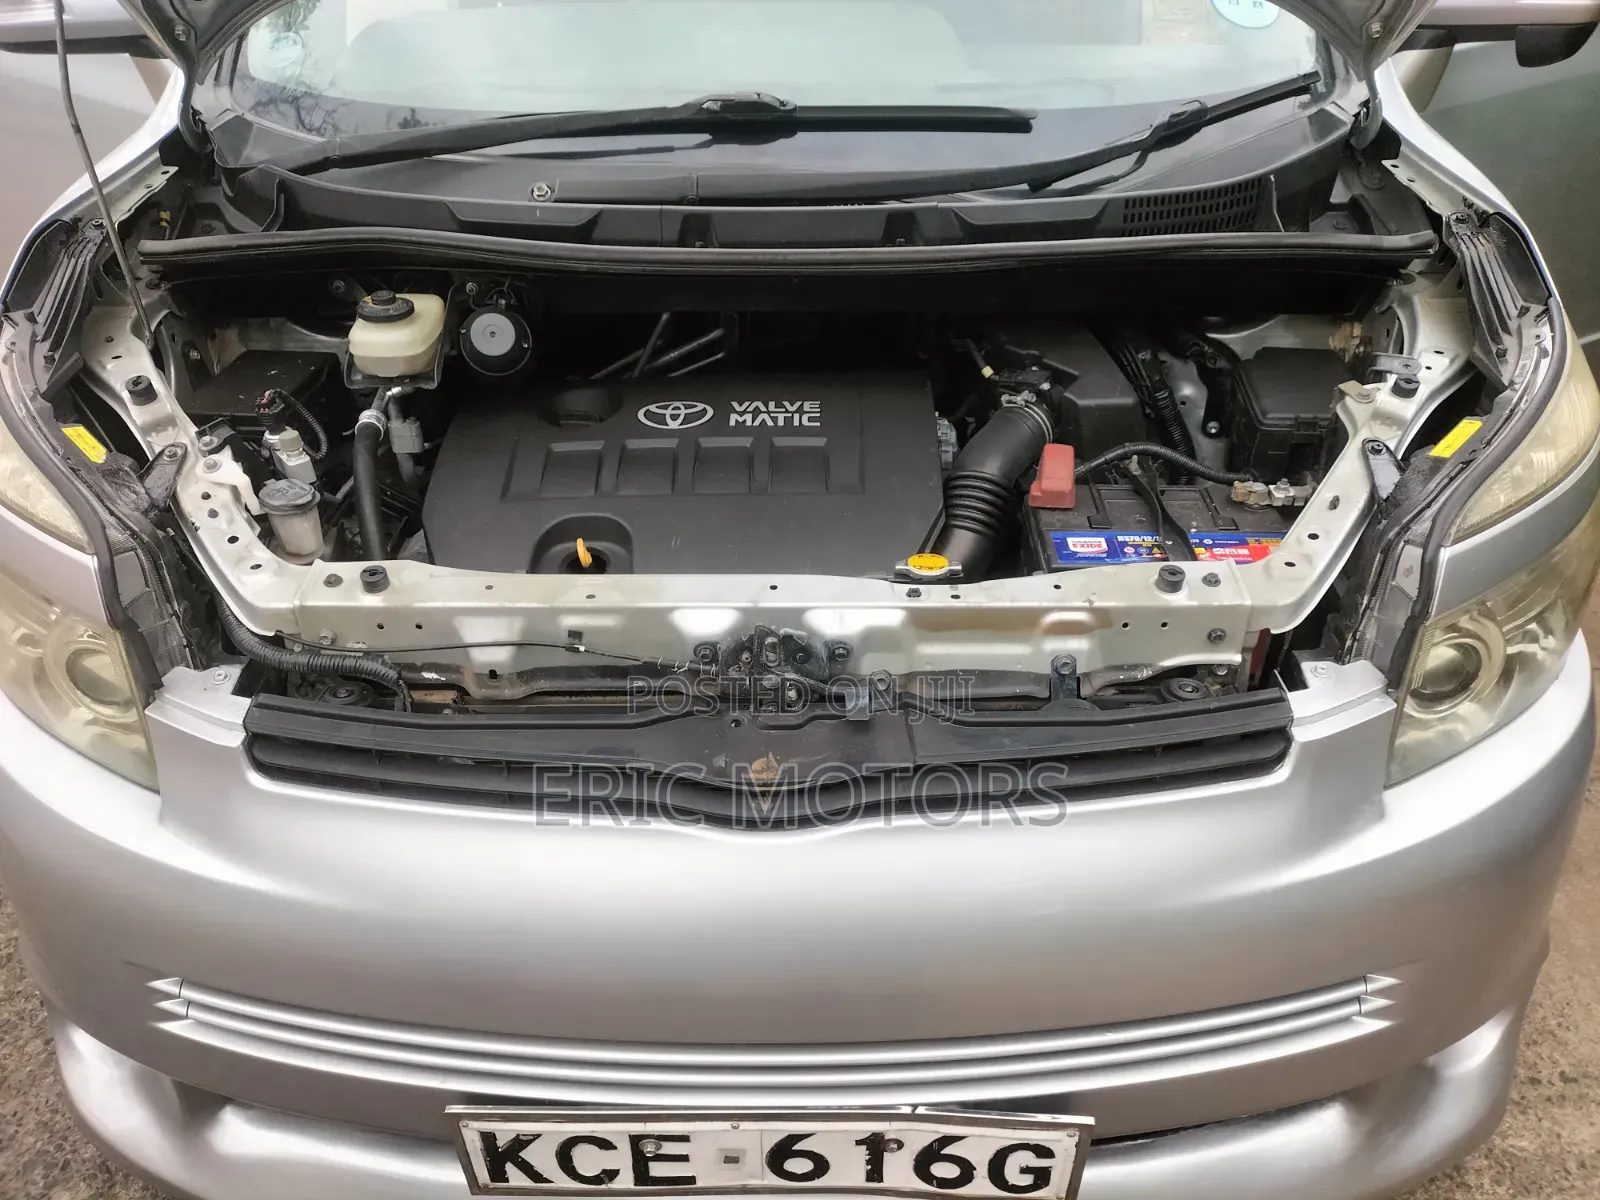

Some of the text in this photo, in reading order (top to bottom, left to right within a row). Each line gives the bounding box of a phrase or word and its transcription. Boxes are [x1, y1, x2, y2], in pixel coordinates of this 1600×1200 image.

[730, 401, 821, 411] VALVE
[729, 413, 821, 426] MATIC
[478, 1131, 1056, 1194] KCE 616G
